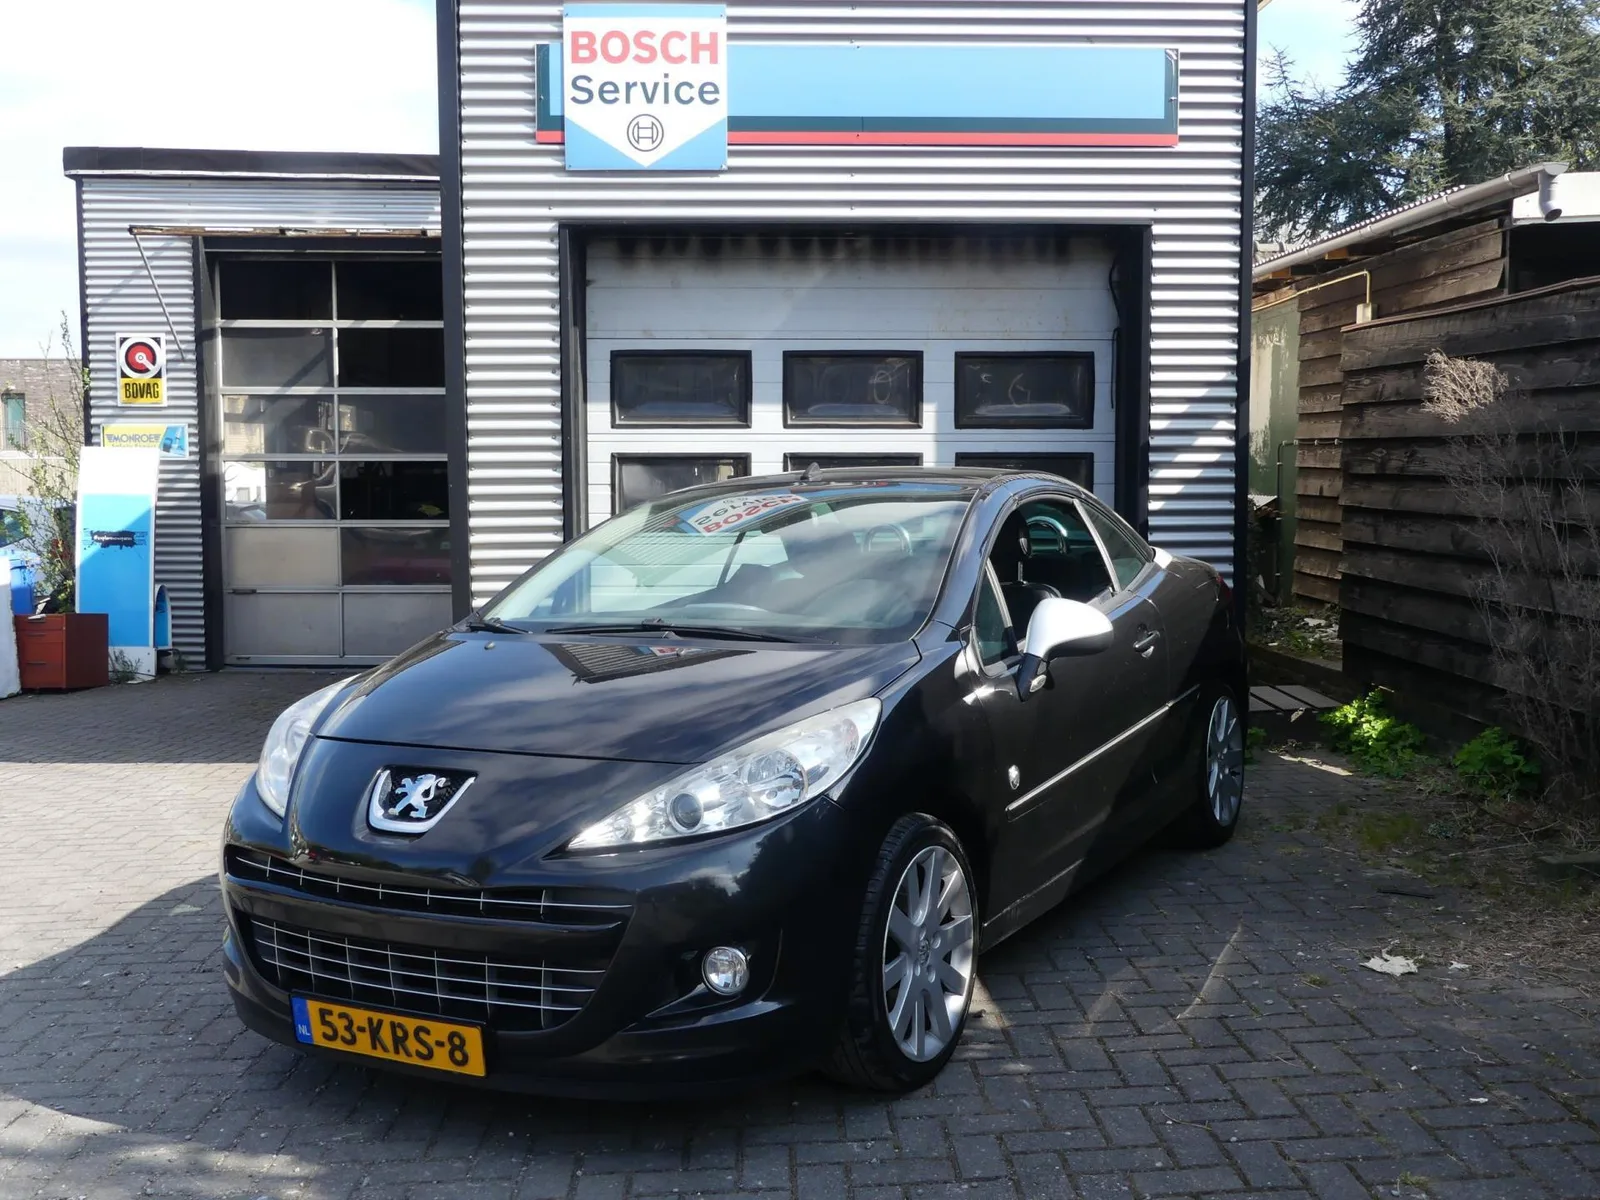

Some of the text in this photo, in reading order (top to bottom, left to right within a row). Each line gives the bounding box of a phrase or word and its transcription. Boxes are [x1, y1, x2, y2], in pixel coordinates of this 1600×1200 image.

[570, 30, 719, 65] BOSCH
[570, 73, 720, 105] Service
[124, 382, 160, 399] BOVAG
[110, 433, 158, 443] MONROE
[298, 1024, 311, 1036] NL
[318, 1007, 470, 1067] 53-KRS-8
